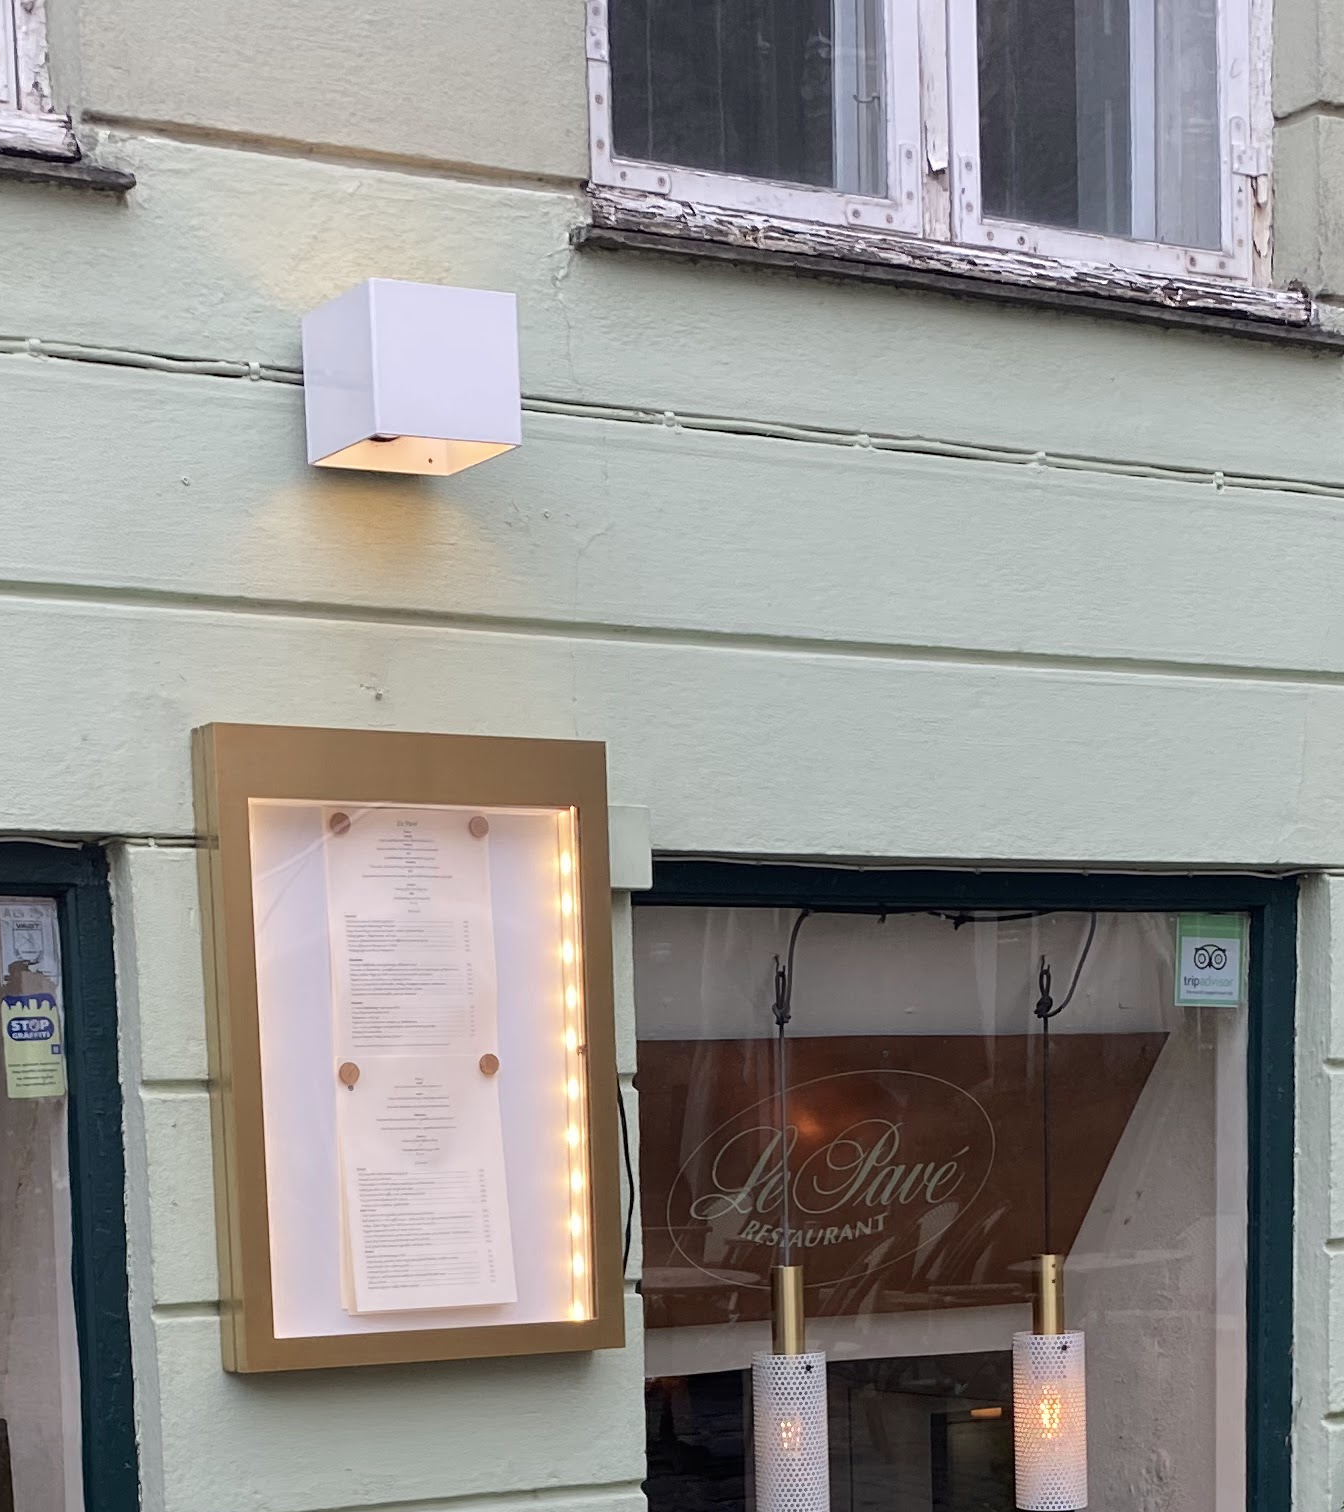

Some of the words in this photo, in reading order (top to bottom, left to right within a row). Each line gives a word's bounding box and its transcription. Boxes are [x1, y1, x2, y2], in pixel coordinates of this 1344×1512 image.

[10, 1018, 50, 1031] STOP
[689, 1124, 798, 1220] Le
[792, 1118, 970, 1215] Pavé
[739, 1211, 889, 1249] RESTAURANT
